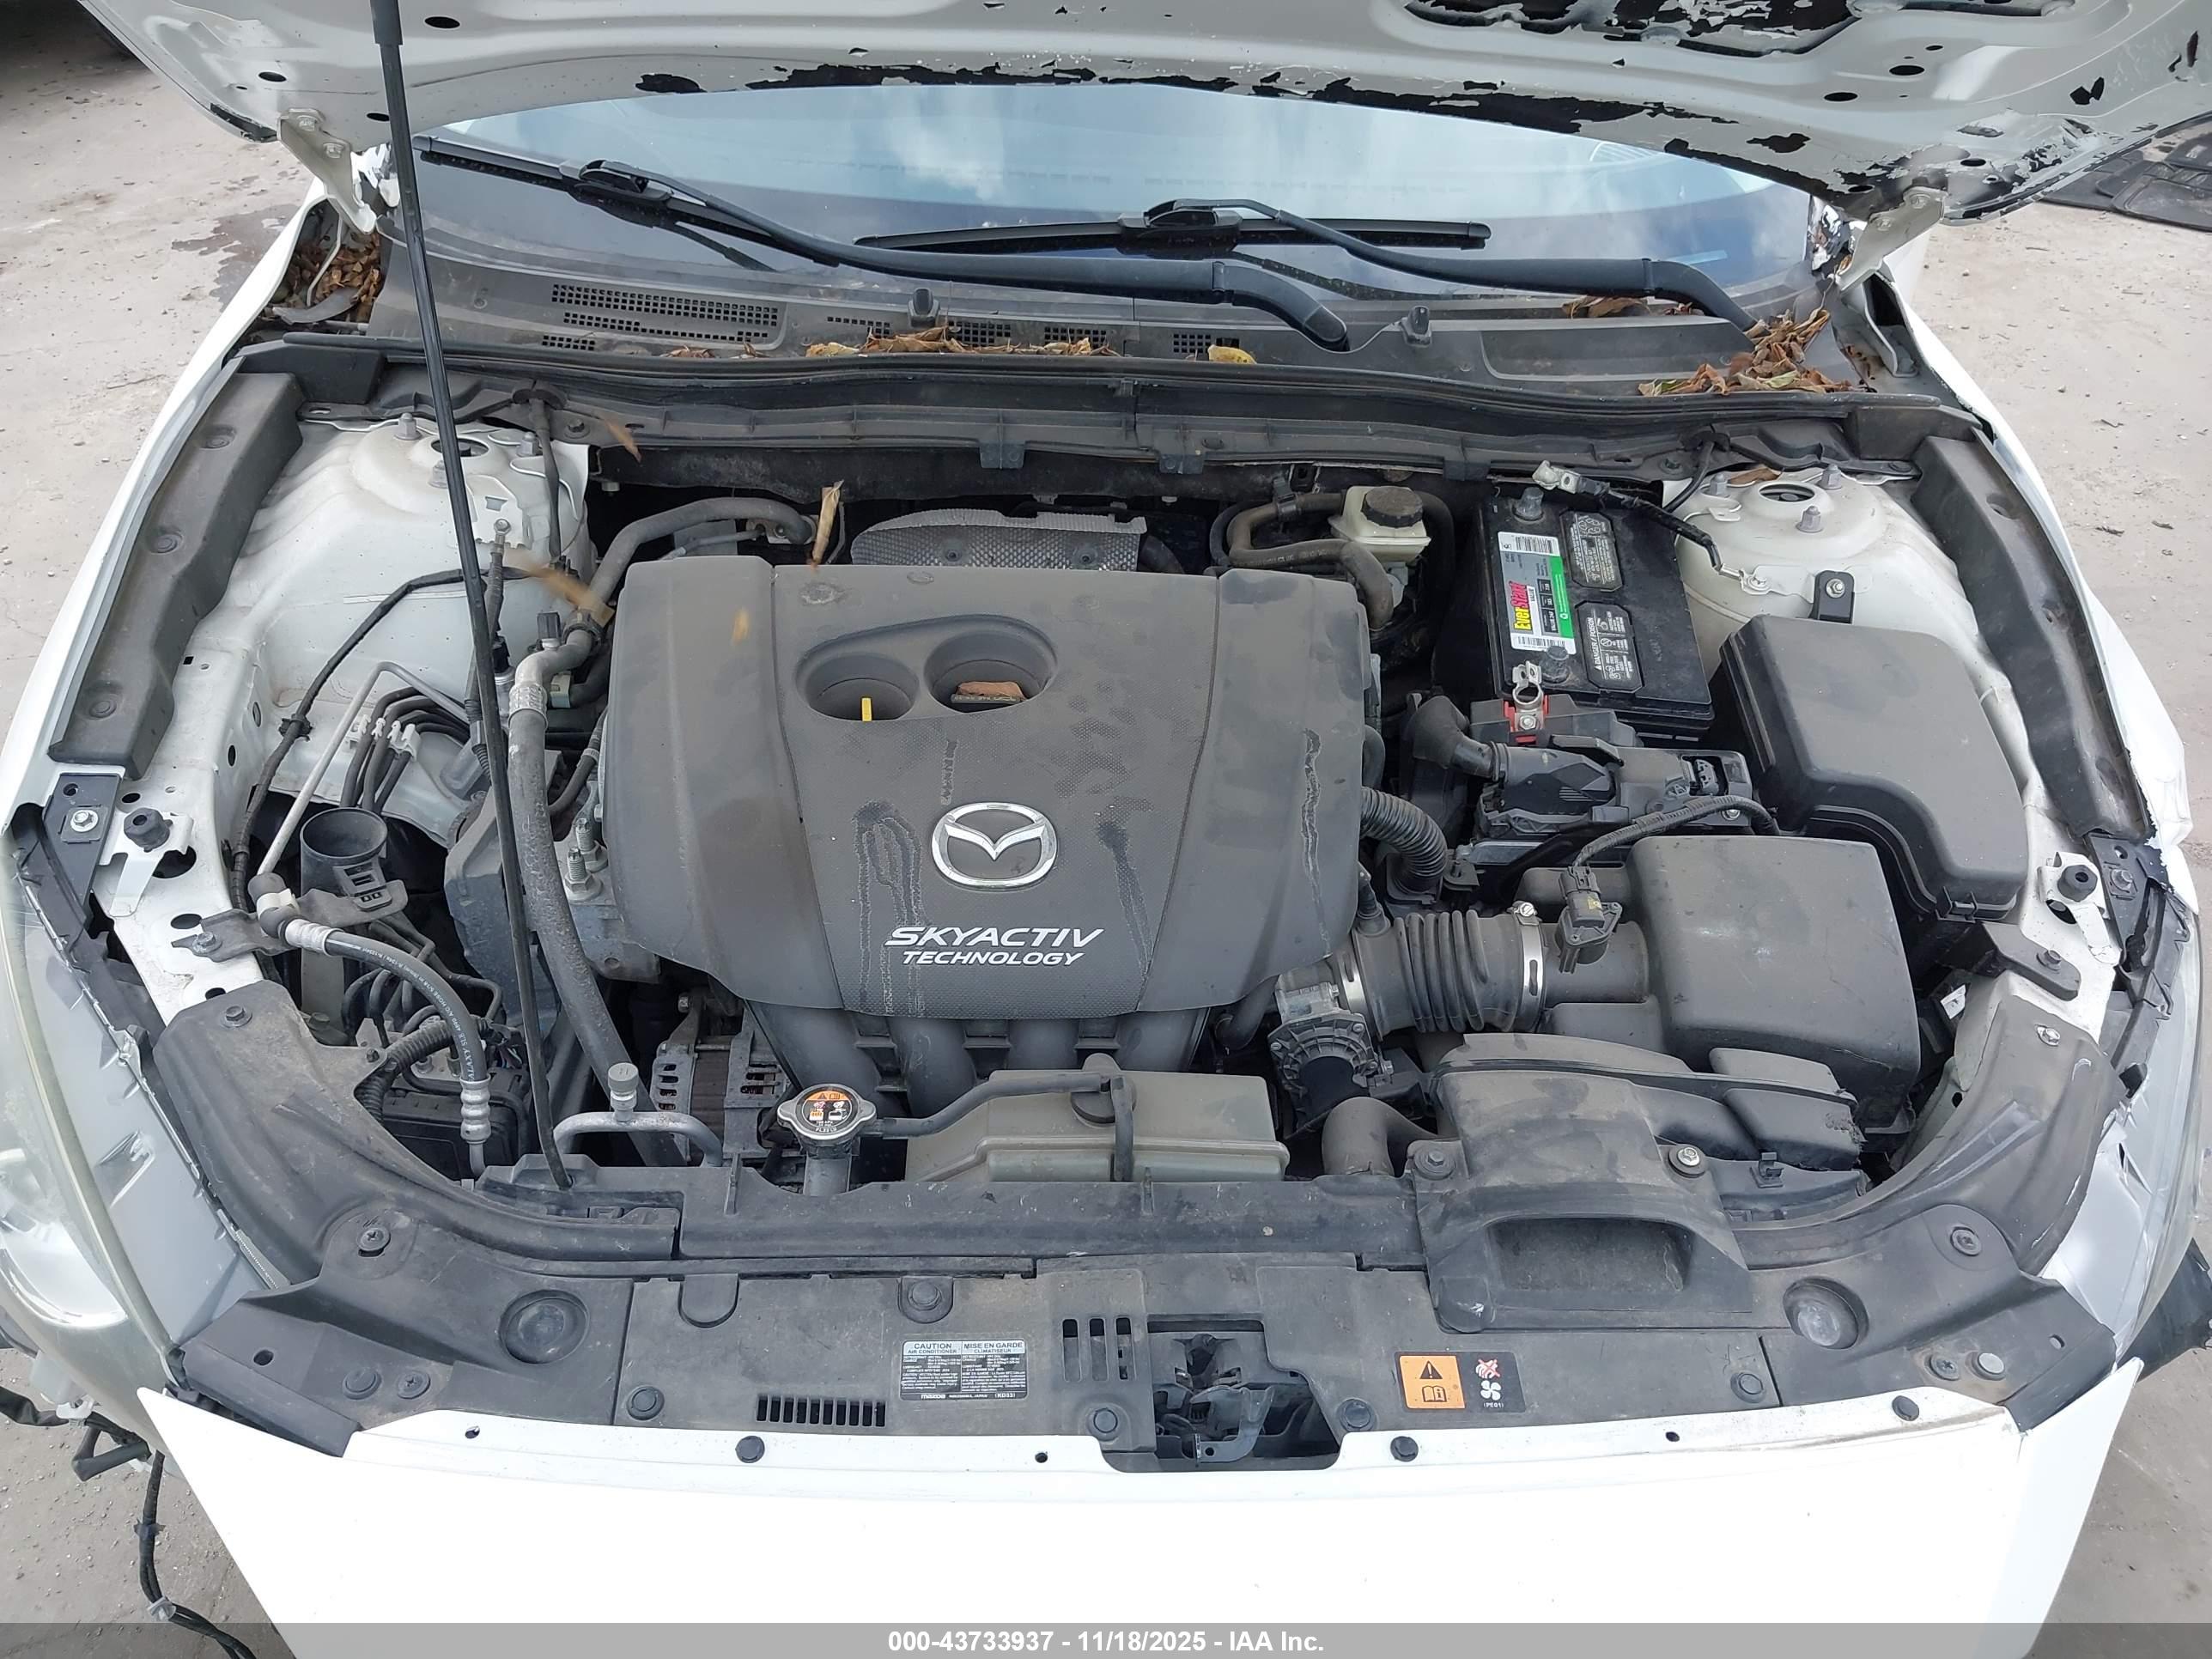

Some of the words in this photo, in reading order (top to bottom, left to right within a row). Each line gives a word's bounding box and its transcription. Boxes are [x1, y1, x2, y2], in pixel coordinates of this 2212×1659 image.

[1587, 617, 1597, 637] POISON
[1591, 641, 1601, 665] DANGER
[884, 927, 1104, 947] SKYACTIV
[902, 951, 1085, 966] TECHNOLOGY
[434, 992, 447, 1010] HOSE
[464, 1048, 475, 1082] ALAXY
